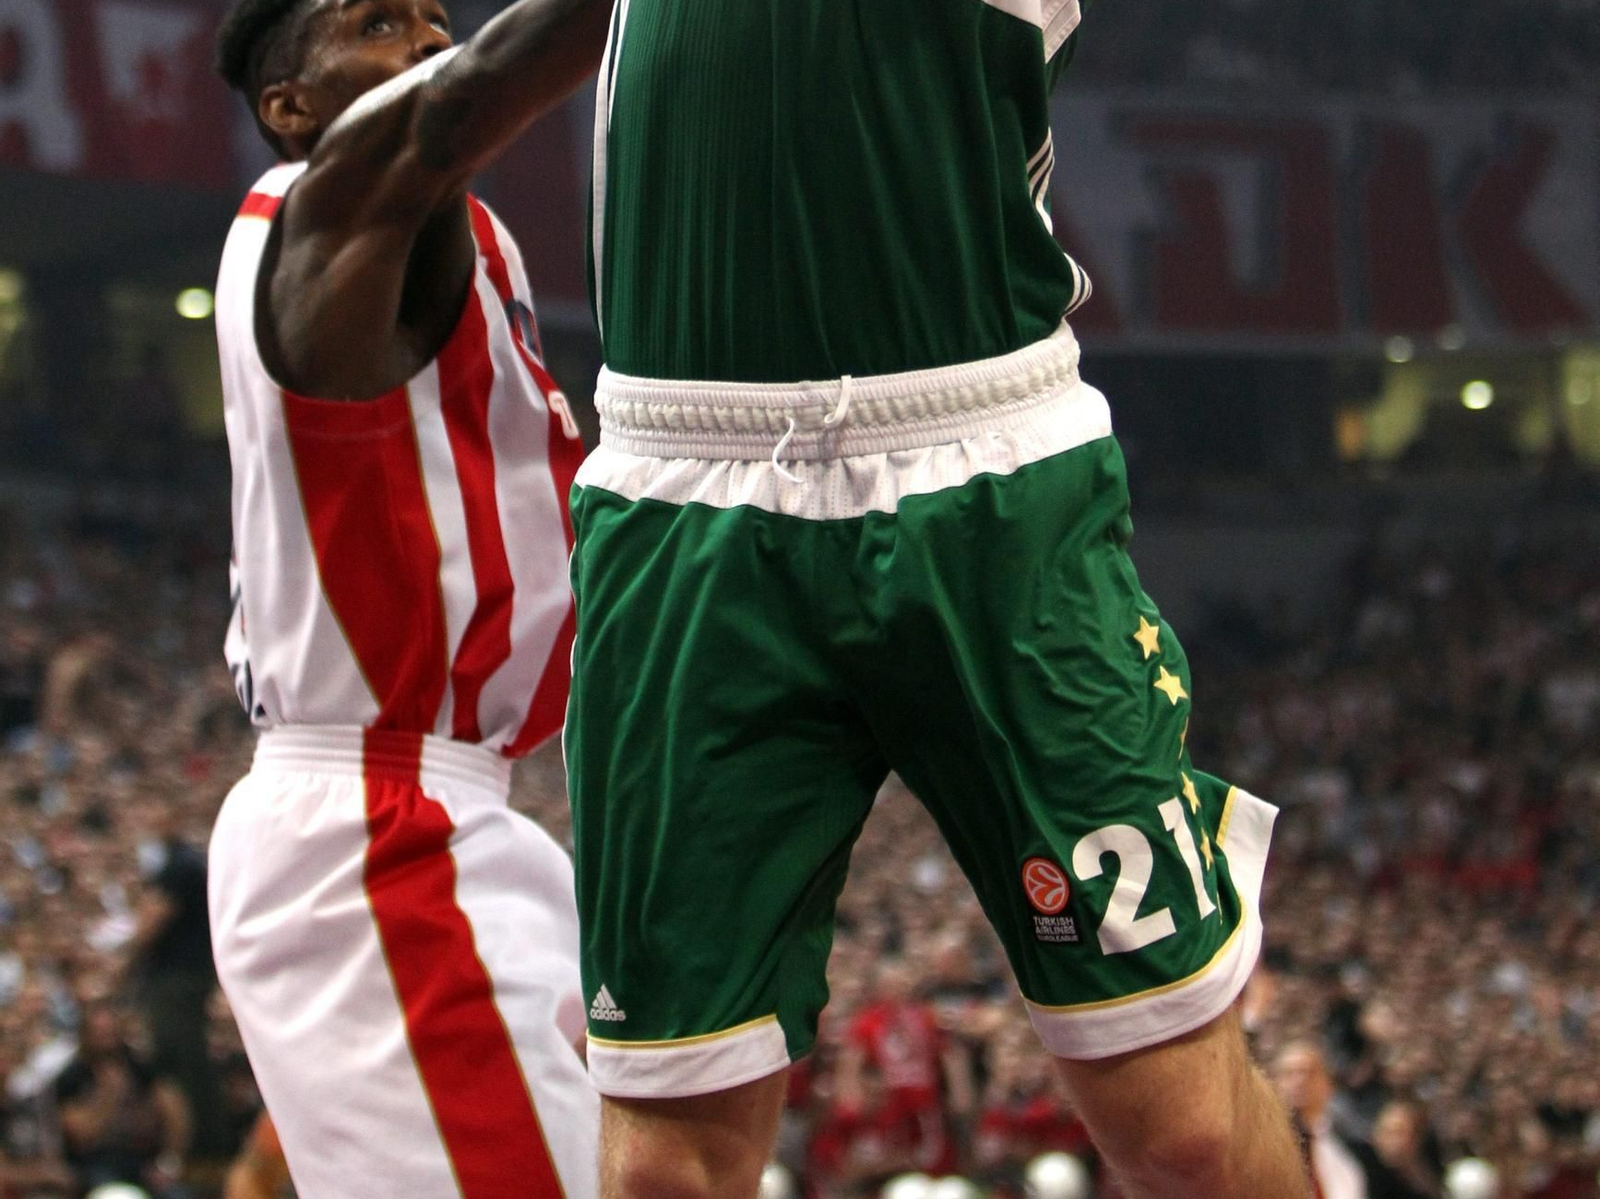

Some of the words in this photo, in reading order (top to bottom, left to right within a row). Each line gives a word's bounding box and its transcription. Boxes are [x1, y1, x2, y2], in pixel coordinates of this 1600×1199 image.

[1072, 796, 1216, 955] 21
[1033, 916, 1073, 926] TURKISH
[1036, 926, 1076, 934] AIRLINES
[590, 1007, 626, 1021] adidas
